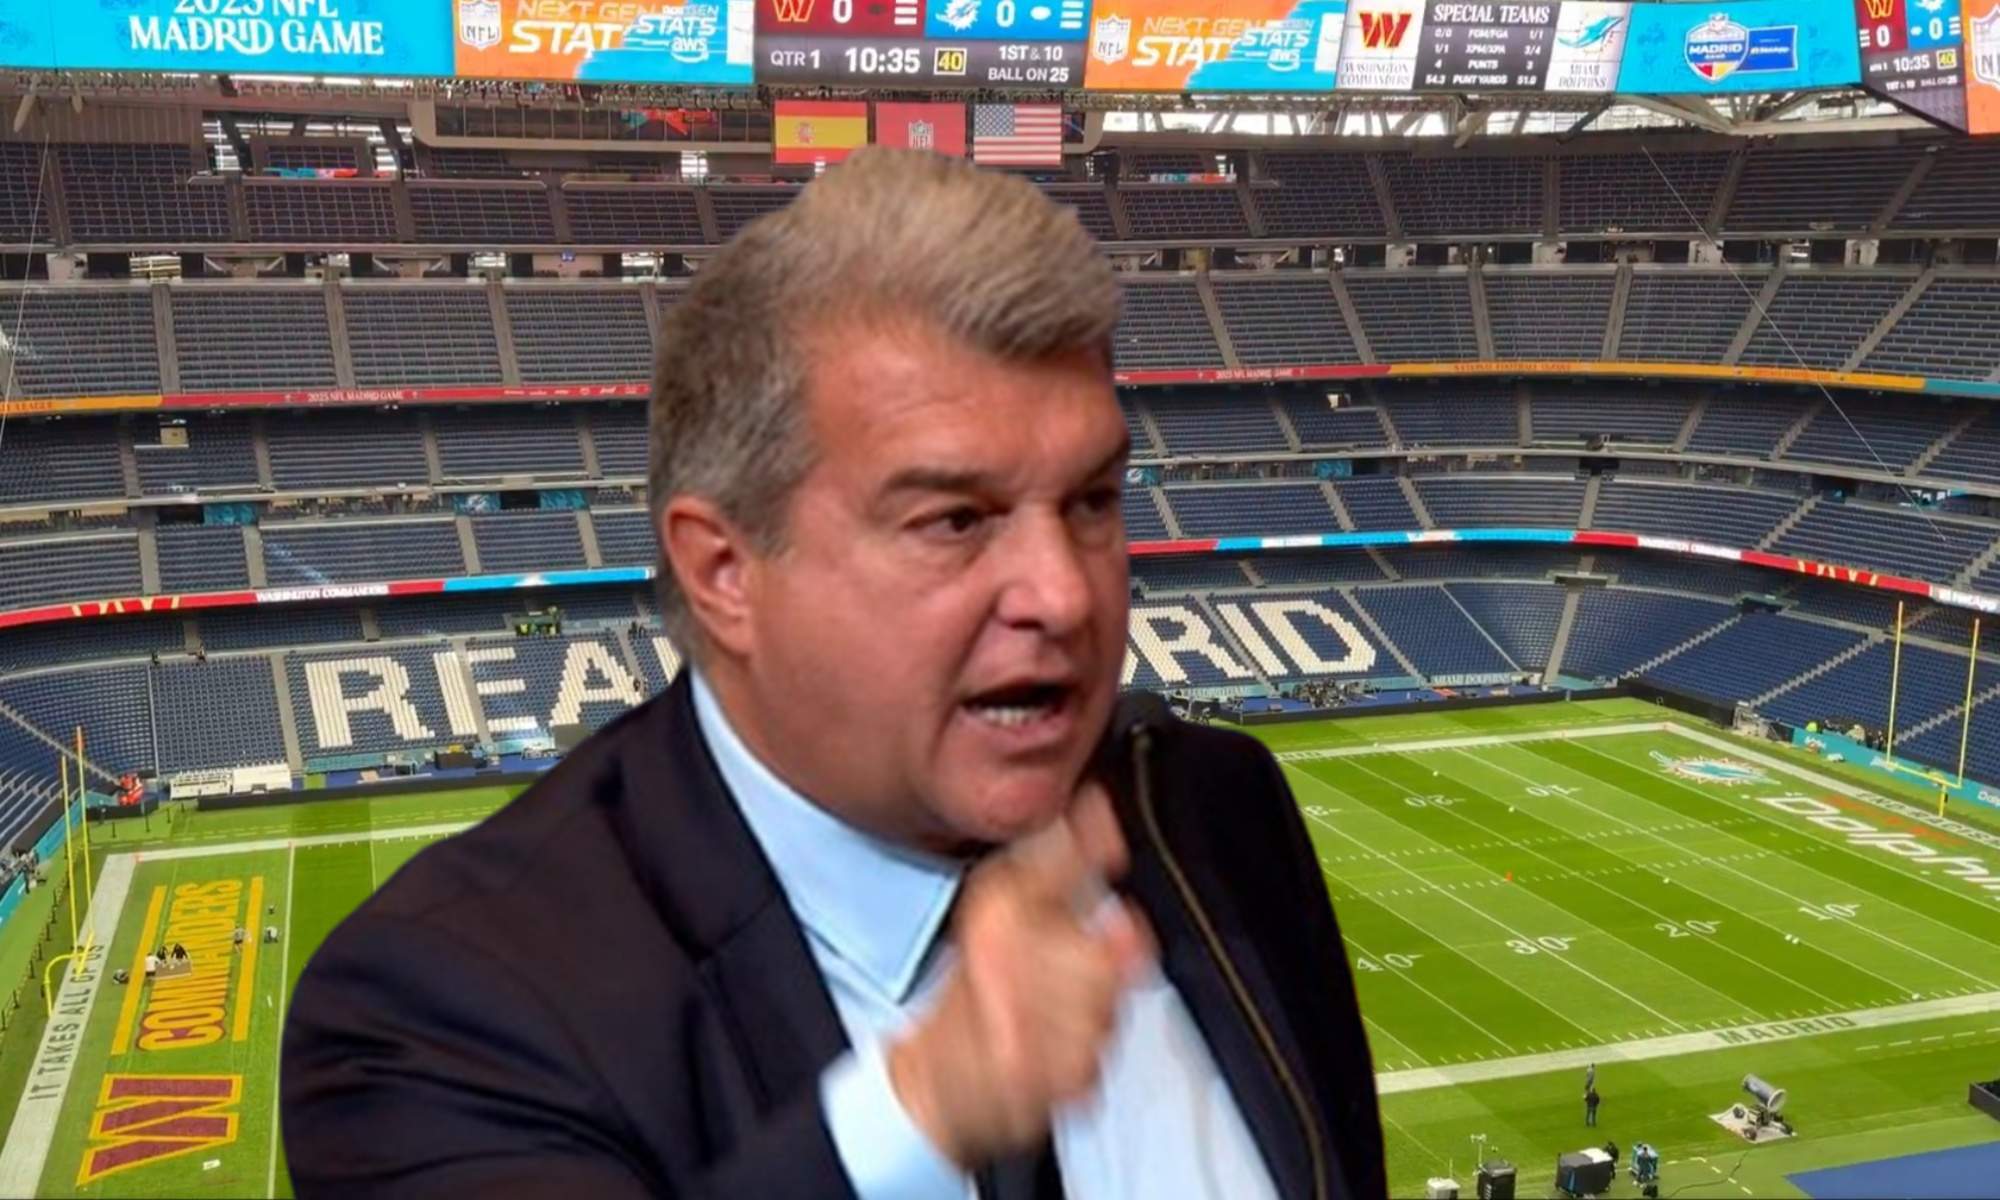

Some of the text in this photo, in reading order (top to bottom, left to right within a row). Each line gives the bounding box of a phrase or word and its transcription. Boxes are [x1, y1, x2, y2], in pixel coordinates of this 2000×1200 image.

[516, 0, 595, 20] NEXT
[832, 0, 853, 24] 0
[996, 0, 1016, 28] 0
[1433, 3, 1551, 24] SPECIAL TEAMS
[129, 15, 384, 56] MADRID GAME
[465, 24, 497, 41] NFL
[635, 14, 719, 37] STATS
[1143, 17, 1209, 35] NEXT
[1876, 25, 1891, 47] 0
[1929, 18, 1944, 40] 0
[509, 20, 630, 56] STAT
[770, 48, 821, 70] QTR 1
[999, 45, 1029, 61] 1ST
[1043, 46, 1064, 61] 10
[1131, 36, 1234, 70] STAT
[1689, 43, 1743, 55] MADRID
[844, 47, 921, 74] 10:35
[938, 51, 963, 71] 40
[1893, 54, 1931, 72] 10:35
[988, 67, 1070, 83] BALL ON 25
[1654, 919, 1717, 939] 20
[1505, 935, 1570, 956] 30
[1356, 952, 1415, 973] 40
[58, 988, 92, 1016] ALL
[1714, 1014, 1858, 1046] MADRID
[37, 1023, 81, 1076] TAKES
[28, 1083, 62, 1101] IT
